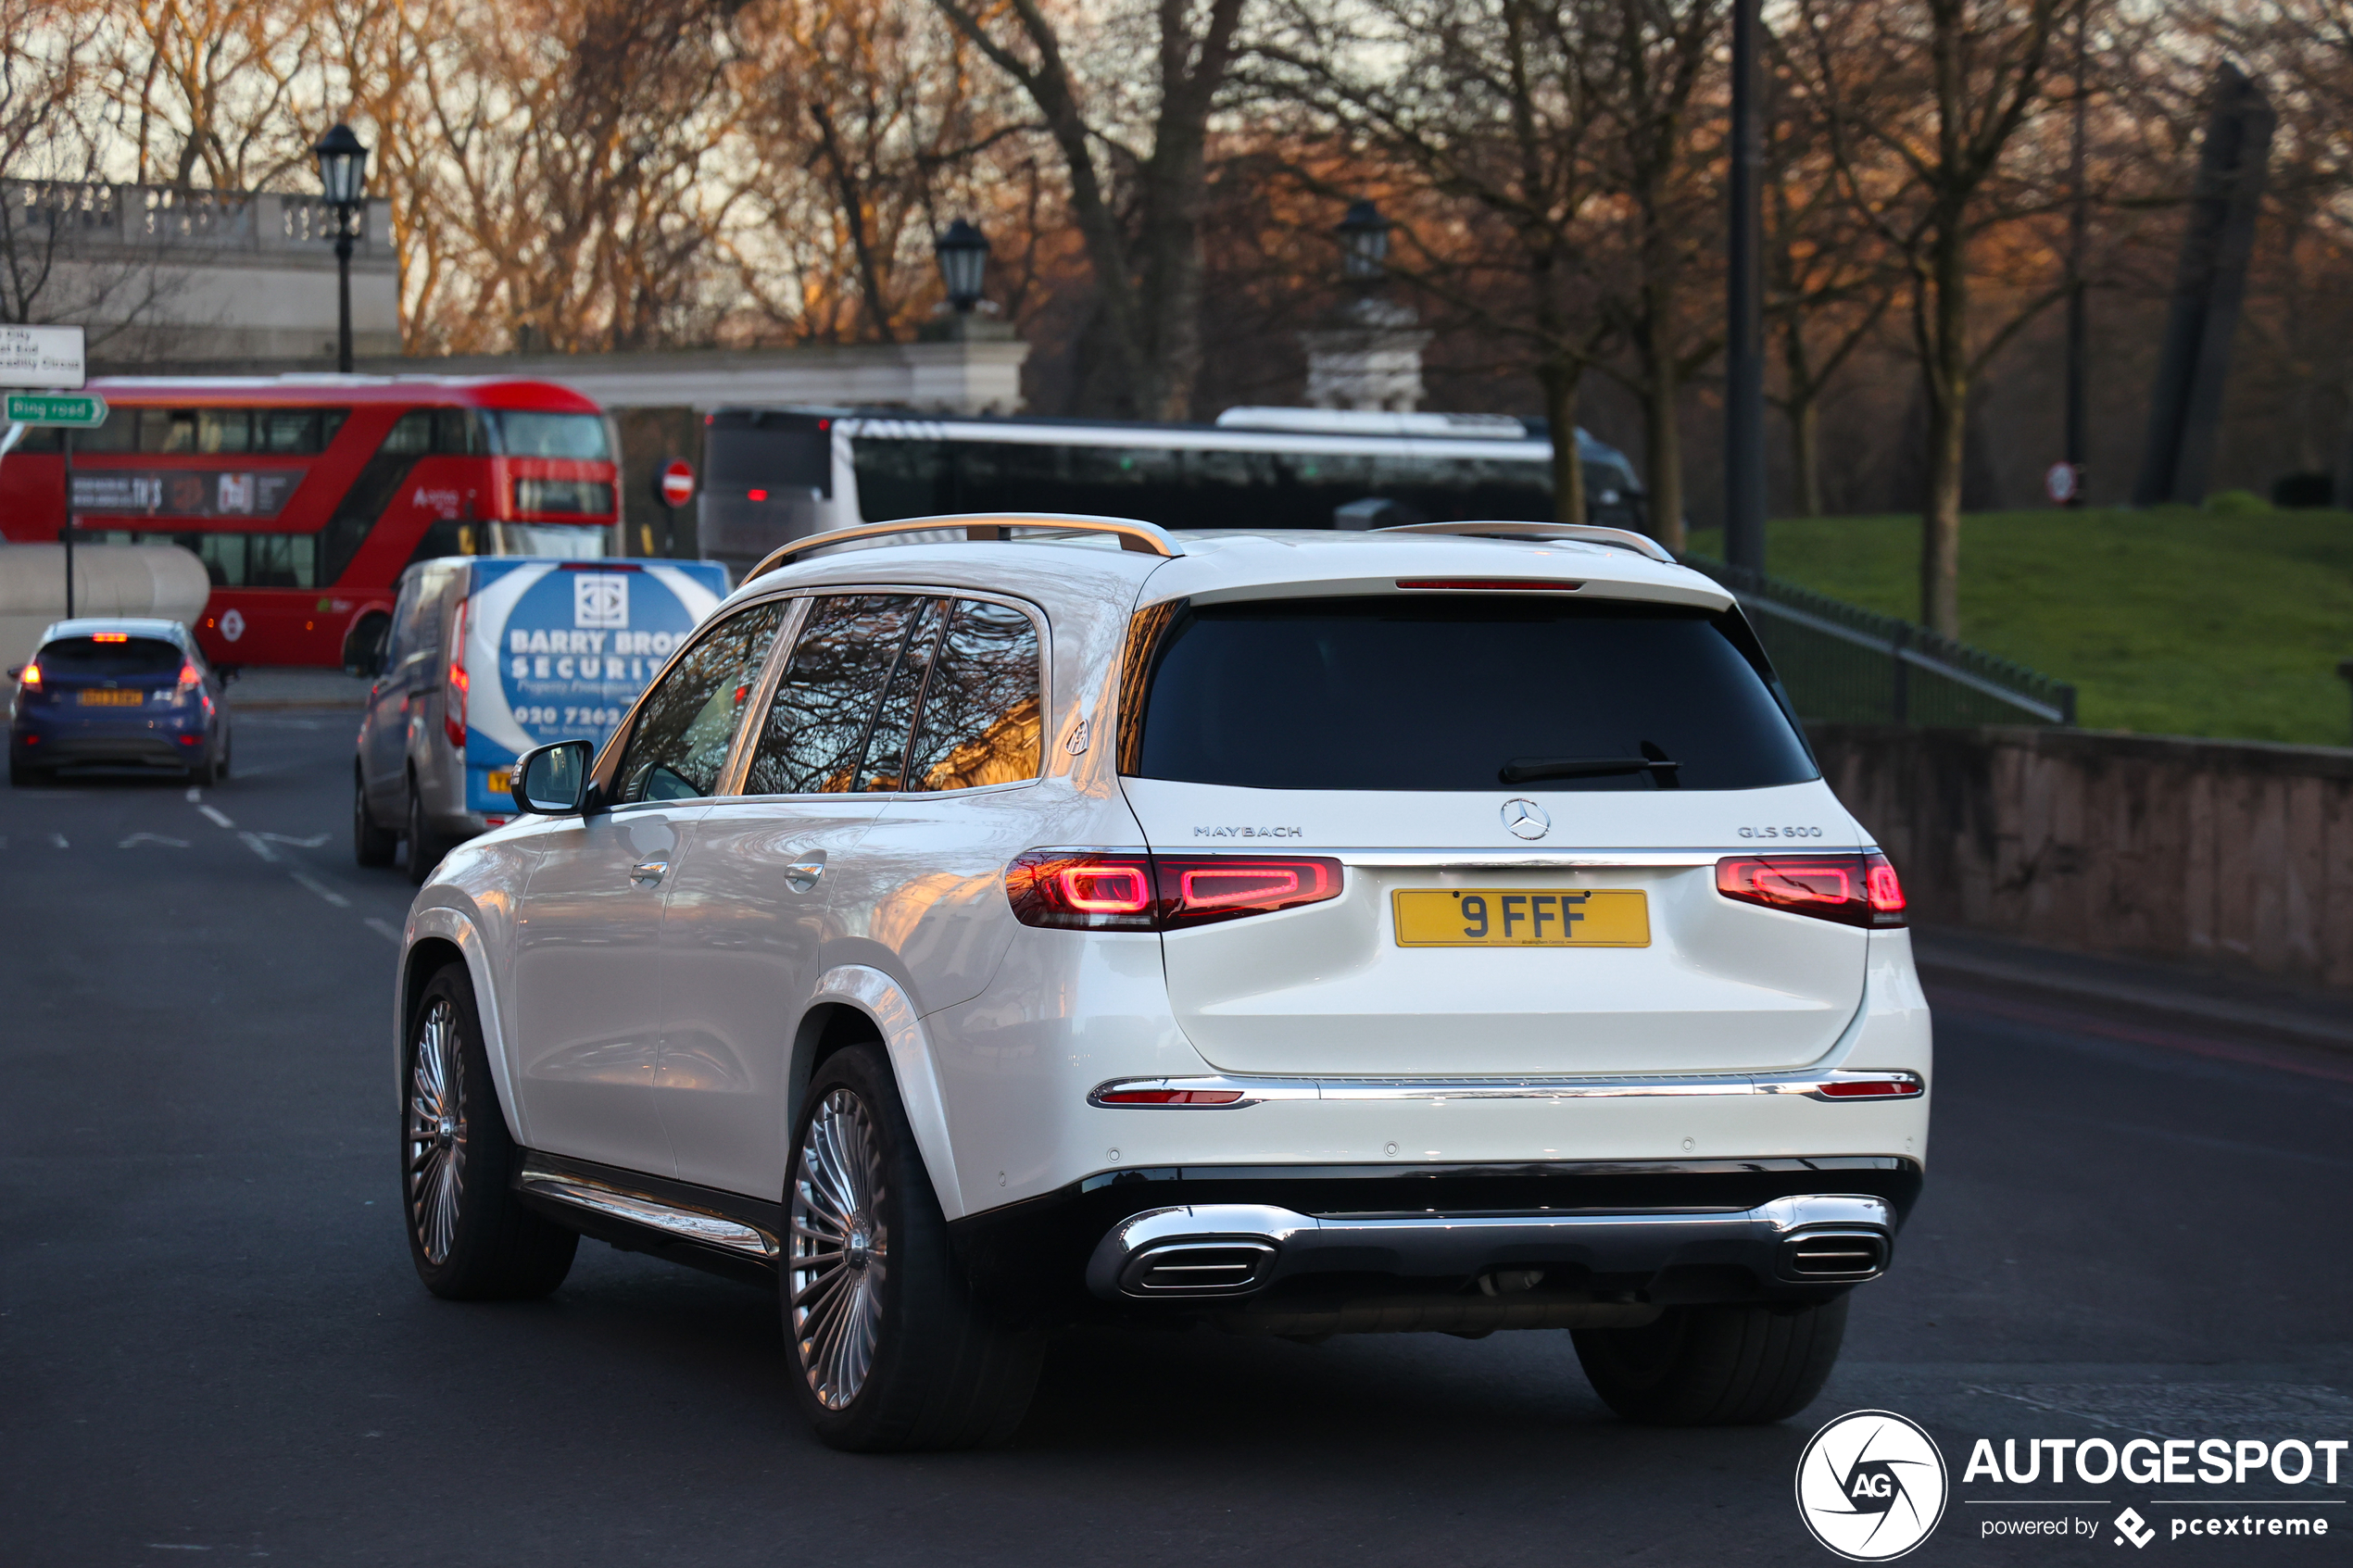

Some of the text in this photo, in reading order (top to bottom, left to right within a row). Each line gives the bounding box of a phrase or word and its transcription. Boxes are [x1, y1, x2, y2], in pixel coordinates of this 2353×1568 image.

[14, 400, 86, 420] Ring road
[510, 629, 686, 656] BARRY BROS
[511, 655, 662, 680] SECURIT
[515, 707, 620, 726] 020 7262
[1193, 826, 1302, 837] MAYBACH
[1737, 826, 1823, 838] GLS 600
[1461, 896, 1587, 938] 9 FFF
